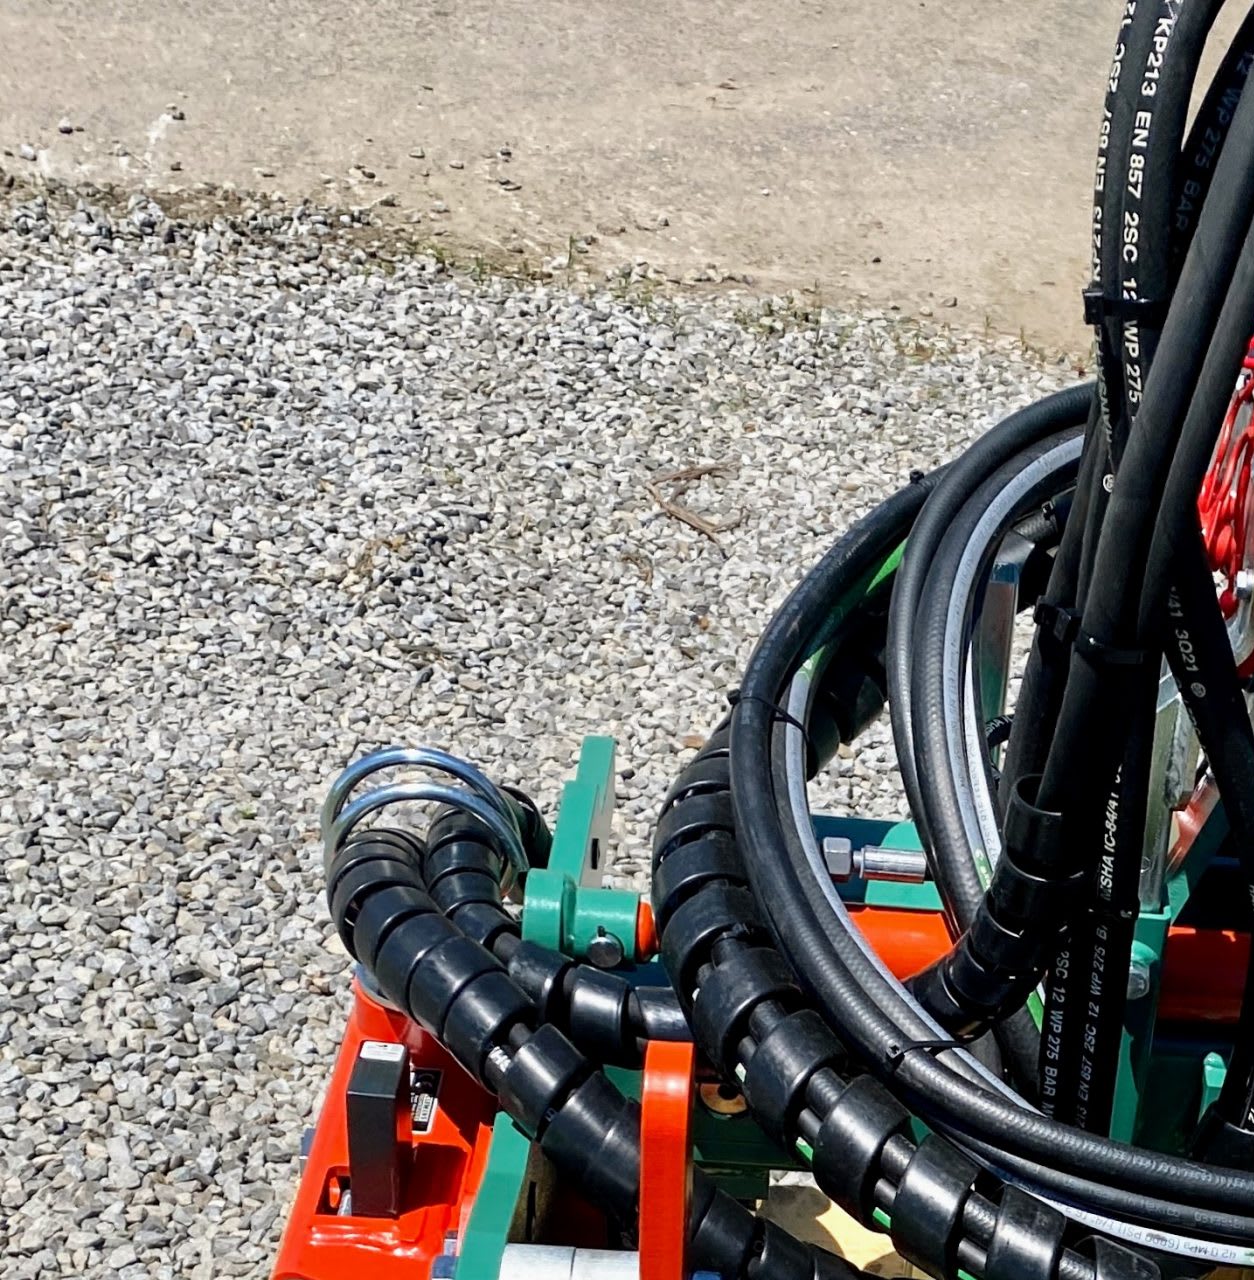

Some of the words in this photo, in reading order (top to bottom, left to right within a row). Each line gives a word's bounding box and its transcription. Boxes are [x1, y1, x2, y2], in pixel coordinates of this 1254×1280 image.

[1141, 17, 1173, 97] KP213
[1132, 111, 1152, 147] EN
[1195, 127, 1222, 168] 275
[1128, 153, 1145, 199] 857
[1175, 179, 1201, 232] BAR
[1123, 211, 1140, 263] 2SC
[1122, 277, 1137, 300] 12
[1124, 320, 1139, 358] WP
[1126, 363, 1143, 403] 275
[1056, 951, 1070, 979] 2SC
[1093, 944, 1106, 972] 275
[1052, 986, 1066, 1003] 12
[1090, 972, 1103, 995] WP
[1049, 1010, 1064, 1034] WP
[1088, 1001, 1100, 1018] 12
[1046, 1034, 1060, 1060] 275
[1084, 1024, 1097, 1054] 2SC
[1042, 1065, 1058, 1097] BAR
[1080, 1055, 1094, 1081] 857
[1078, 1080, 1090, 1101] EN
